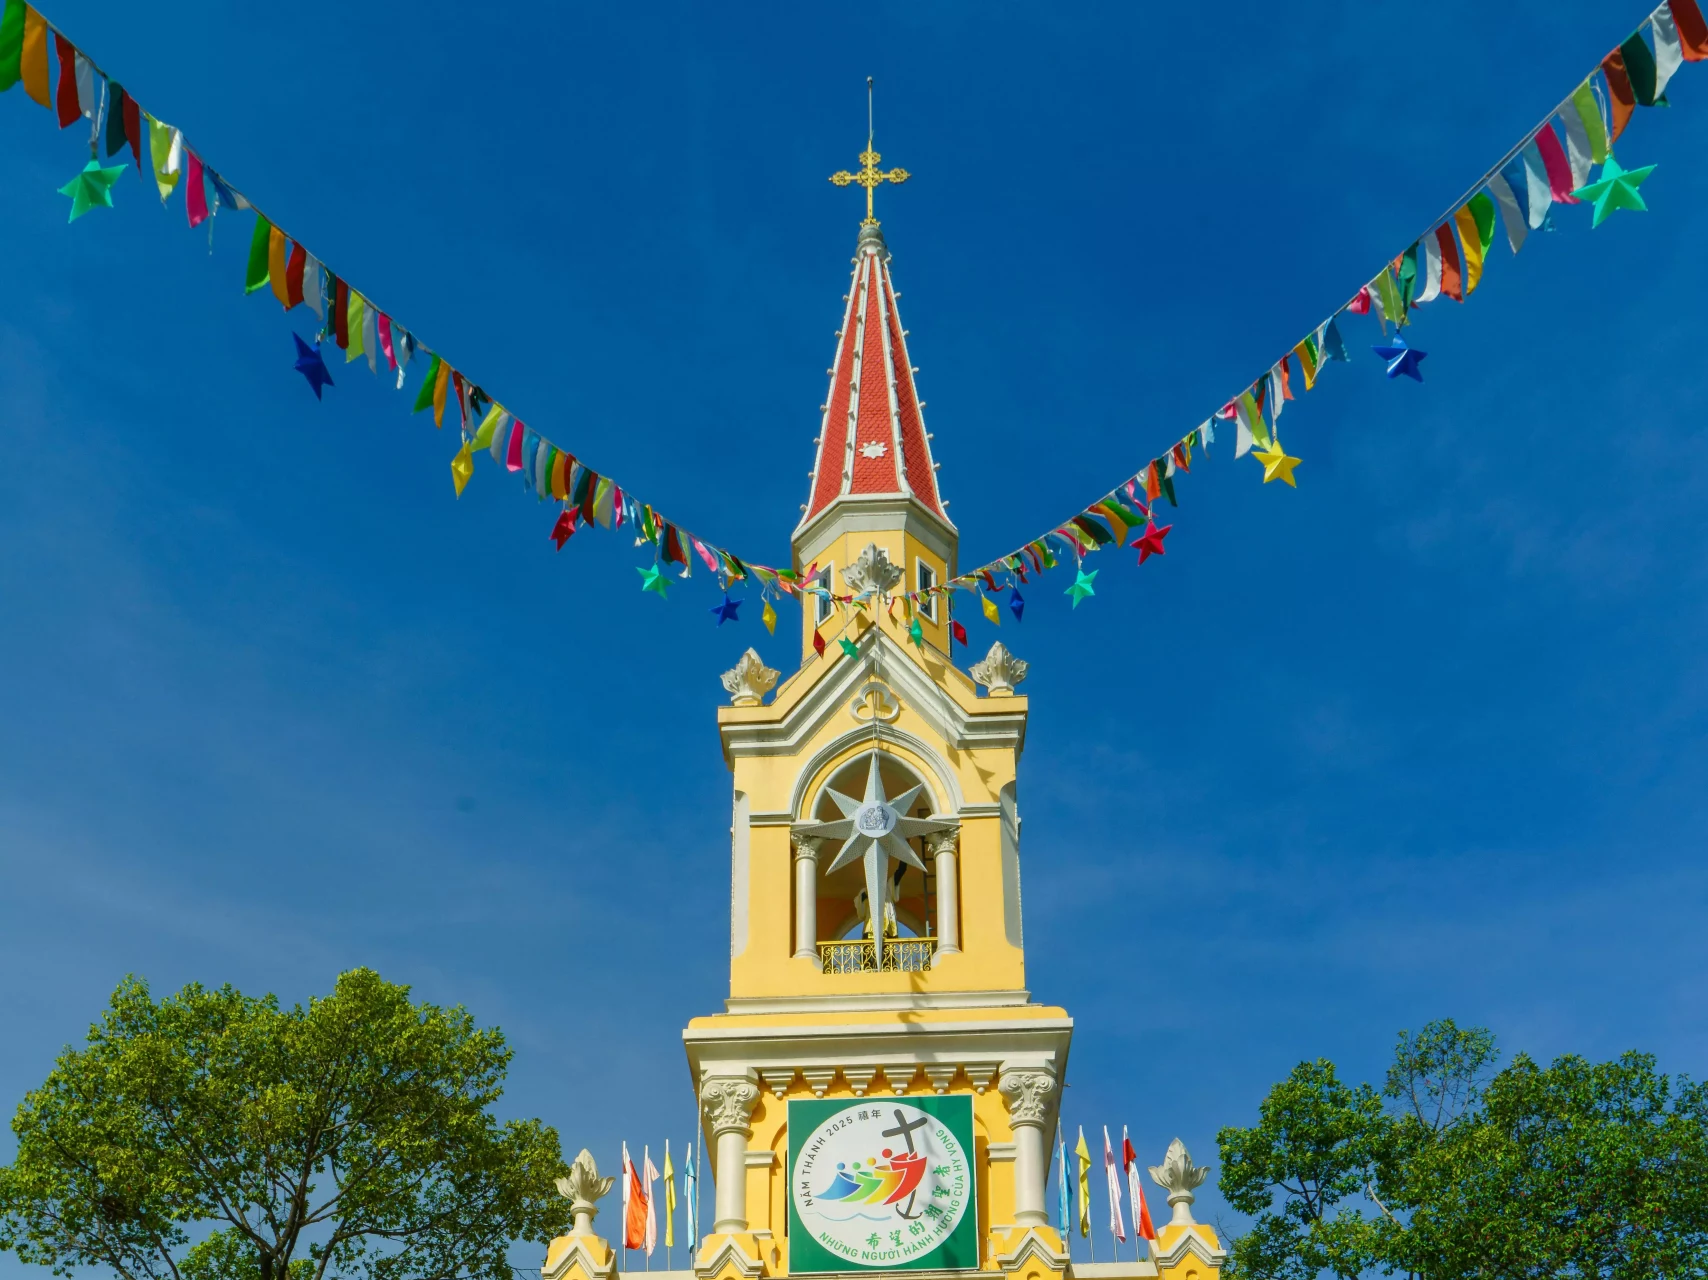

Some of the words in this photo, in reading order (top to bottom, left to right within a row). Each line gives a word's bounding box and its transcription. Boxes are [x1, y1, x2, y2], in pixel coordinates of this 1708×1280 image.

[826, 1116, 853, 1136] 2025
[858, 1109, 882, 1122] 禧年
[936, 1129, 957, 1157] VỌNG
[802, 1137, 826, 1175] THÁNH
[952, 1159, 963, 1172] HY
[800, 1181, 814, 1207] NĂM
[951, 1175, 964, 1197] CỦA
[933, 1199, 960, 1236] HƯƠNG
[819, 1231, 859, 1258] NHỮNG
[862, 1248, 901, 1261] NGƯỜI
[903, 1234, 934, 1256] HÀNH
